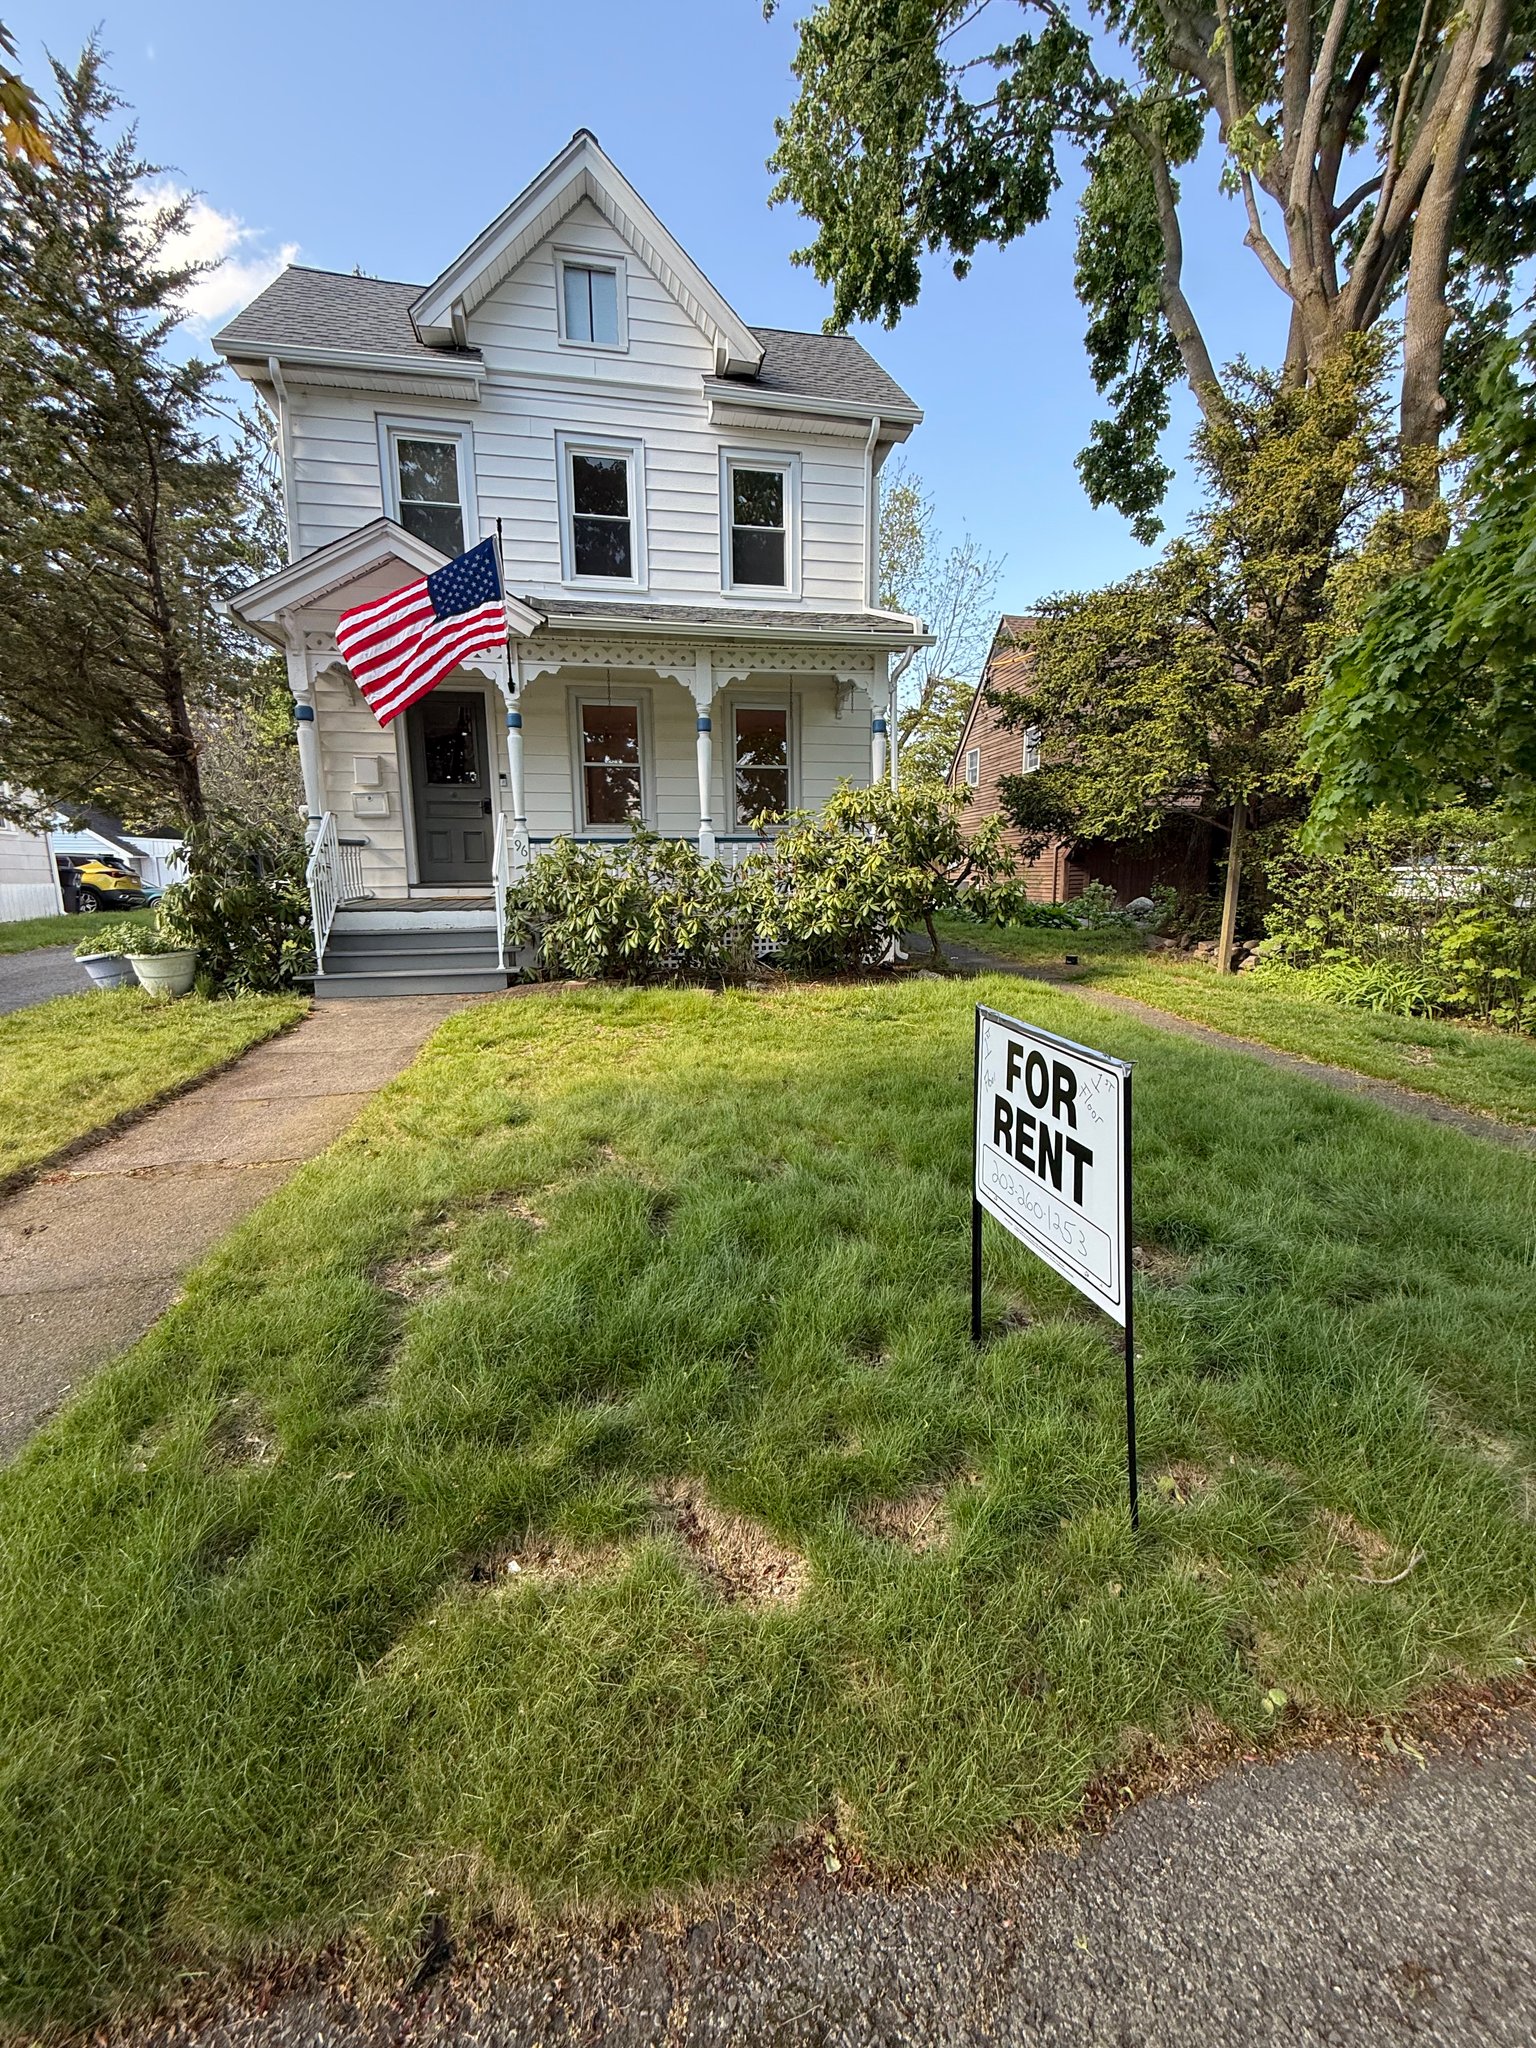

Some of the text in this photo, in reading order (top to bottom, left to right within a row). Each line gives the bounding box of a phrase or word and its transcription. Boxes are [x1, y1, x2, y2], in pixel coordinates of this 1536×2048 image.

[514, 839, 528, 857] 96
[1005, 1039, 1078, 1131] FOR
[1079, 1082, 1104, 1123] Floor
[993, 1093, 1094, 1208] RENT
